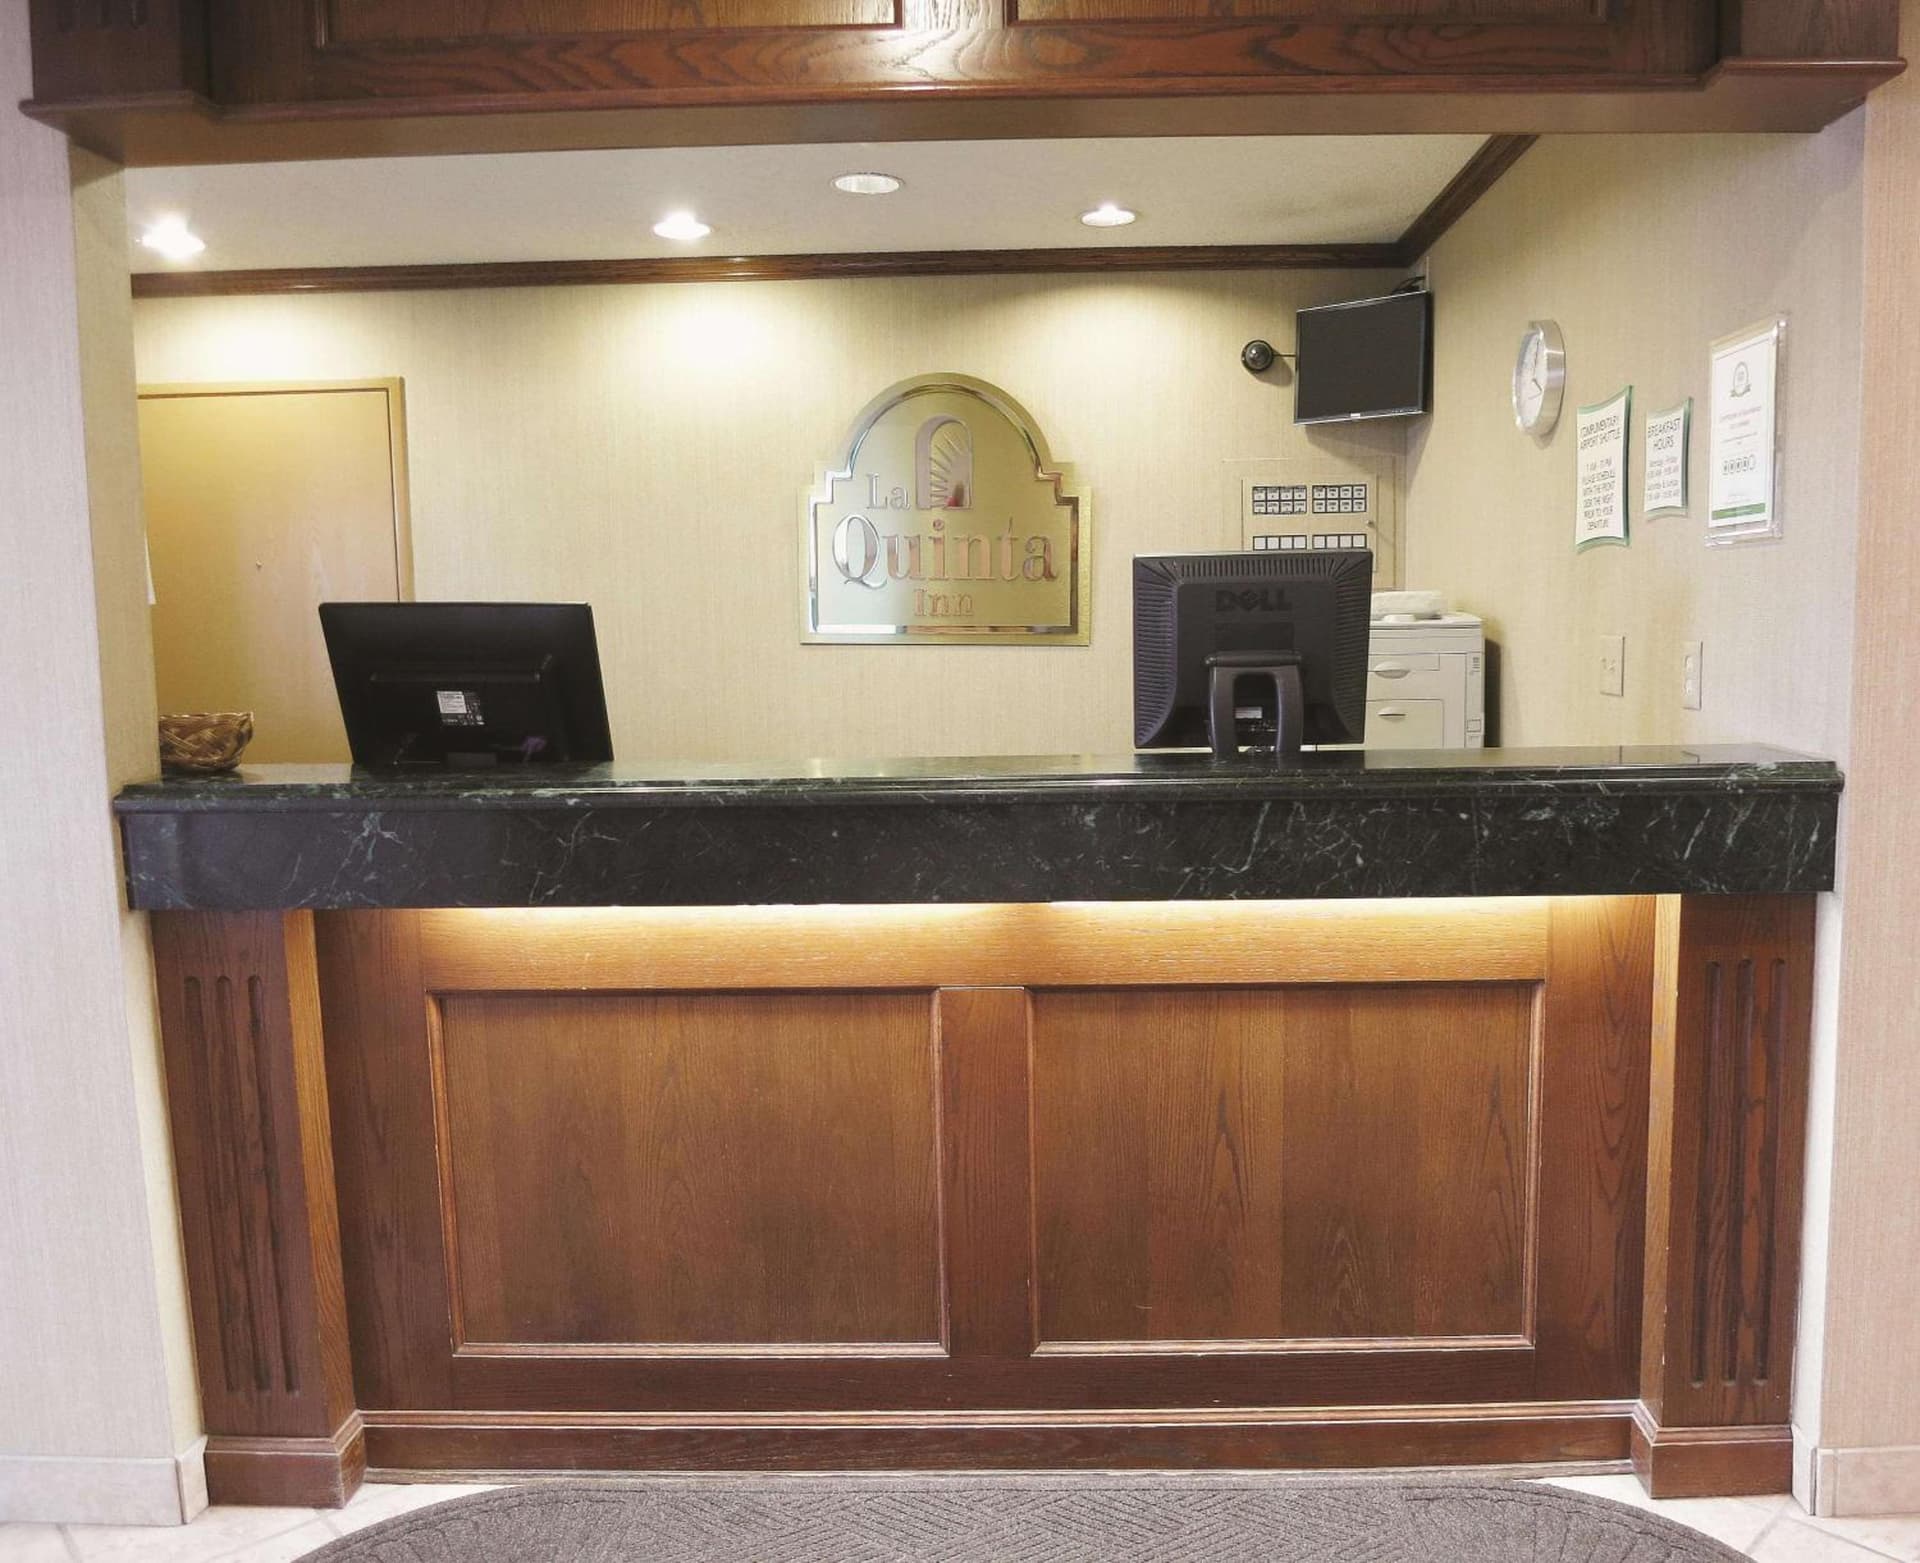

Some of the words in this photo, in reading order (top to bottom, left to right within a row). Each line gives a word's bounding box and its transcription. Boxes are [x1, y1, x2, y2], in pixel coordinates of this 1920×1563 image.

[1647, 417, 1680, 439] BREAKFAST
[1653, 435, 1674, 450] HOURS
[866, 472, 910, 510] La
[832, 515, 1058, 589] Quinta
[914, 588, 973, 616] Inn
[1215, 589, 1293, 612] DELL
